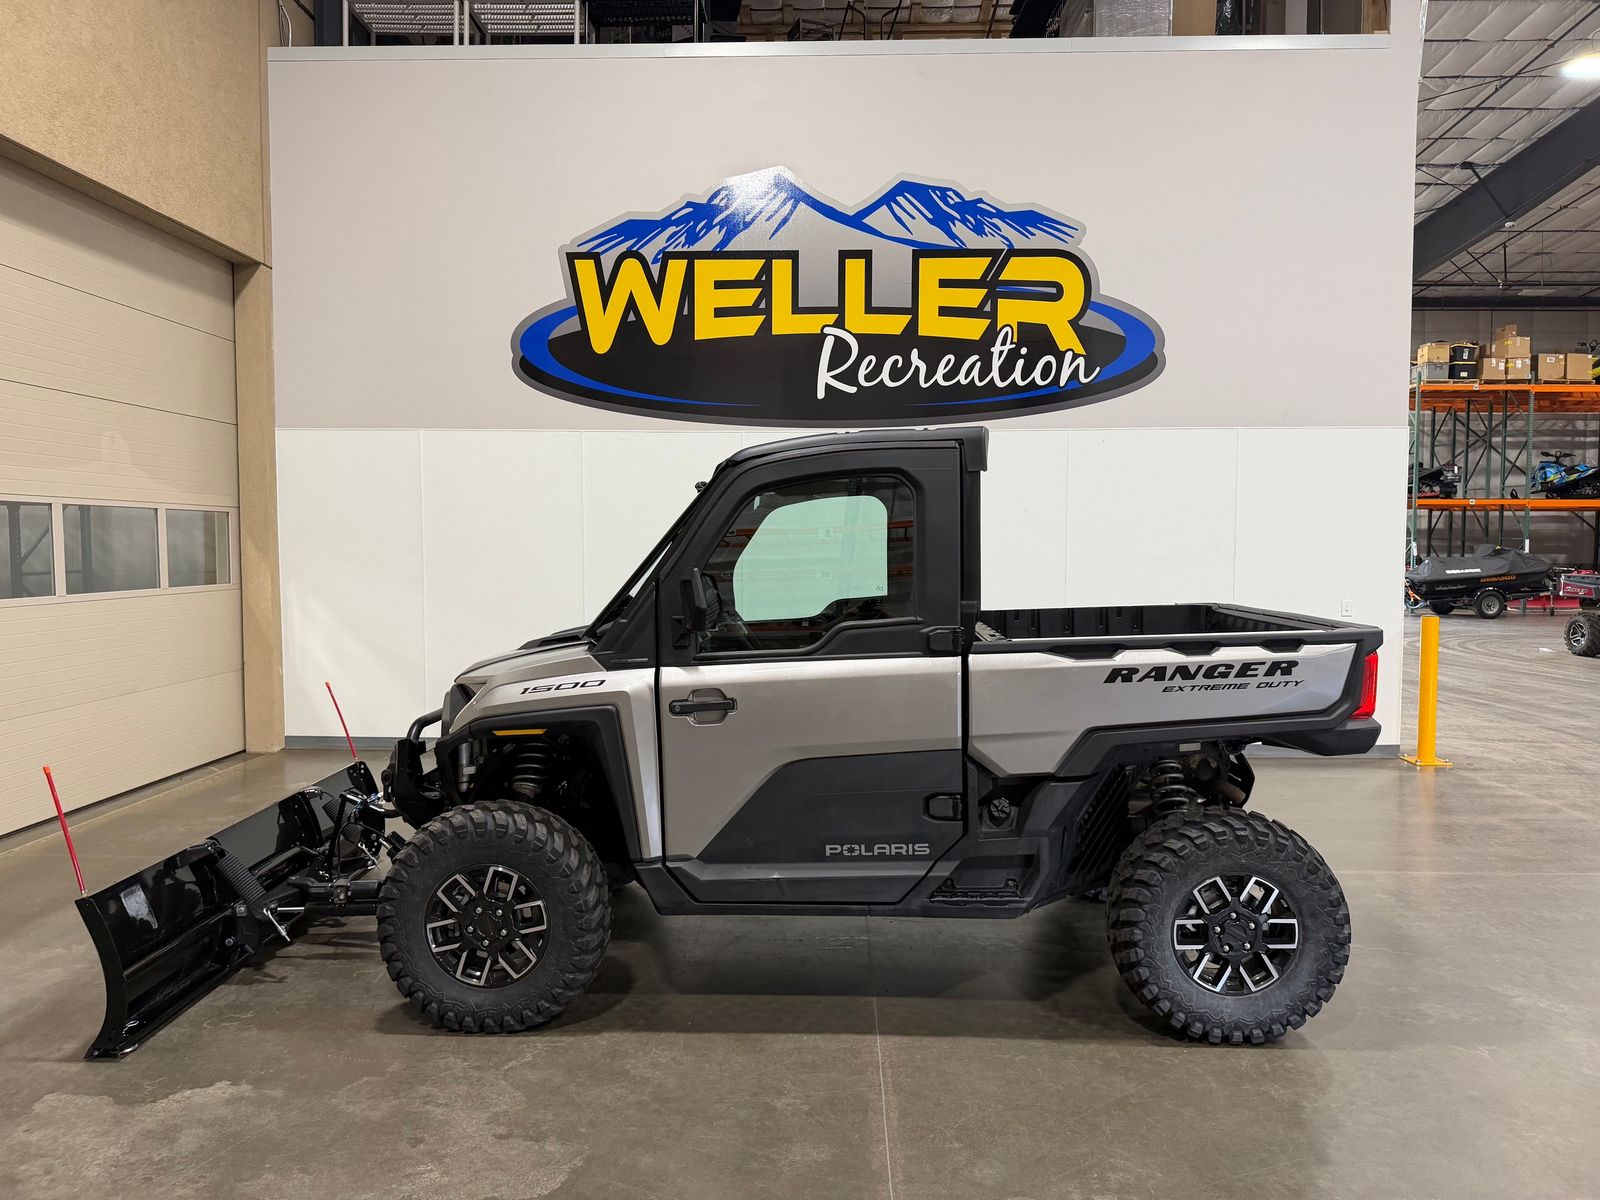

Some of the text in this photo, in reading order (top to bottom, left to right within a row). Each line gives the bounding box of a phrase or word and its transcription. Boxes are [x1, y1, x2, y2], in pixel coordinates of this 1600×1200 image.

[573, 256, 1087, 356] WELLER
[816, 326, 1101, 400] Recreation
[1103, 660, 1300, 684] RANGER
[520, 679, 607, 696] 1500
[1161, 679, 1305, 693] EXTREME DUTY
[824, 843, 931, 857] POLARIS
